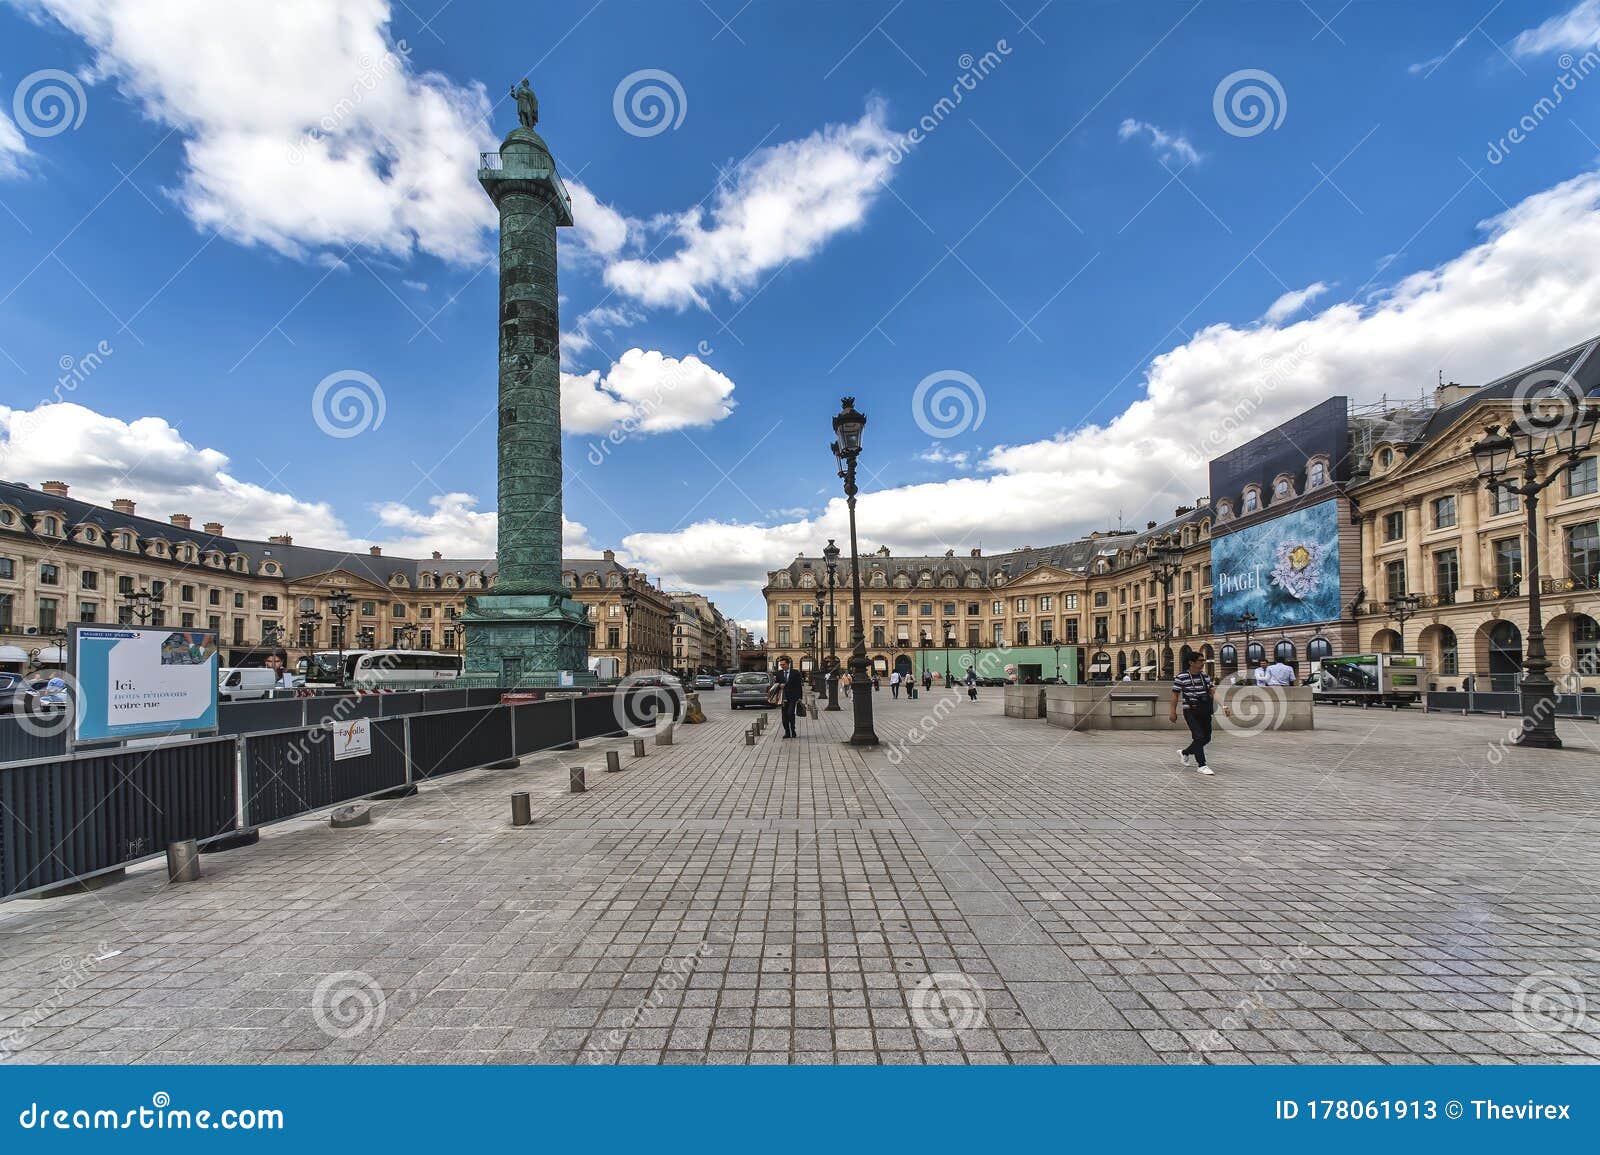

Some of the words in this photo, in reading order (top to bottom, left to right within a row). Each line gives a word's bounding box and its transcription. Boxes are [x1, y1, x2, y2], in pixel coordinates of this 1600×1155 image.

[1219, 563, 1263, 597] PIAGET
[115, 679, 136, 691] Ici,
[143, 690, 188, 699] rénovons
[113, 702, 141, 710] votre
